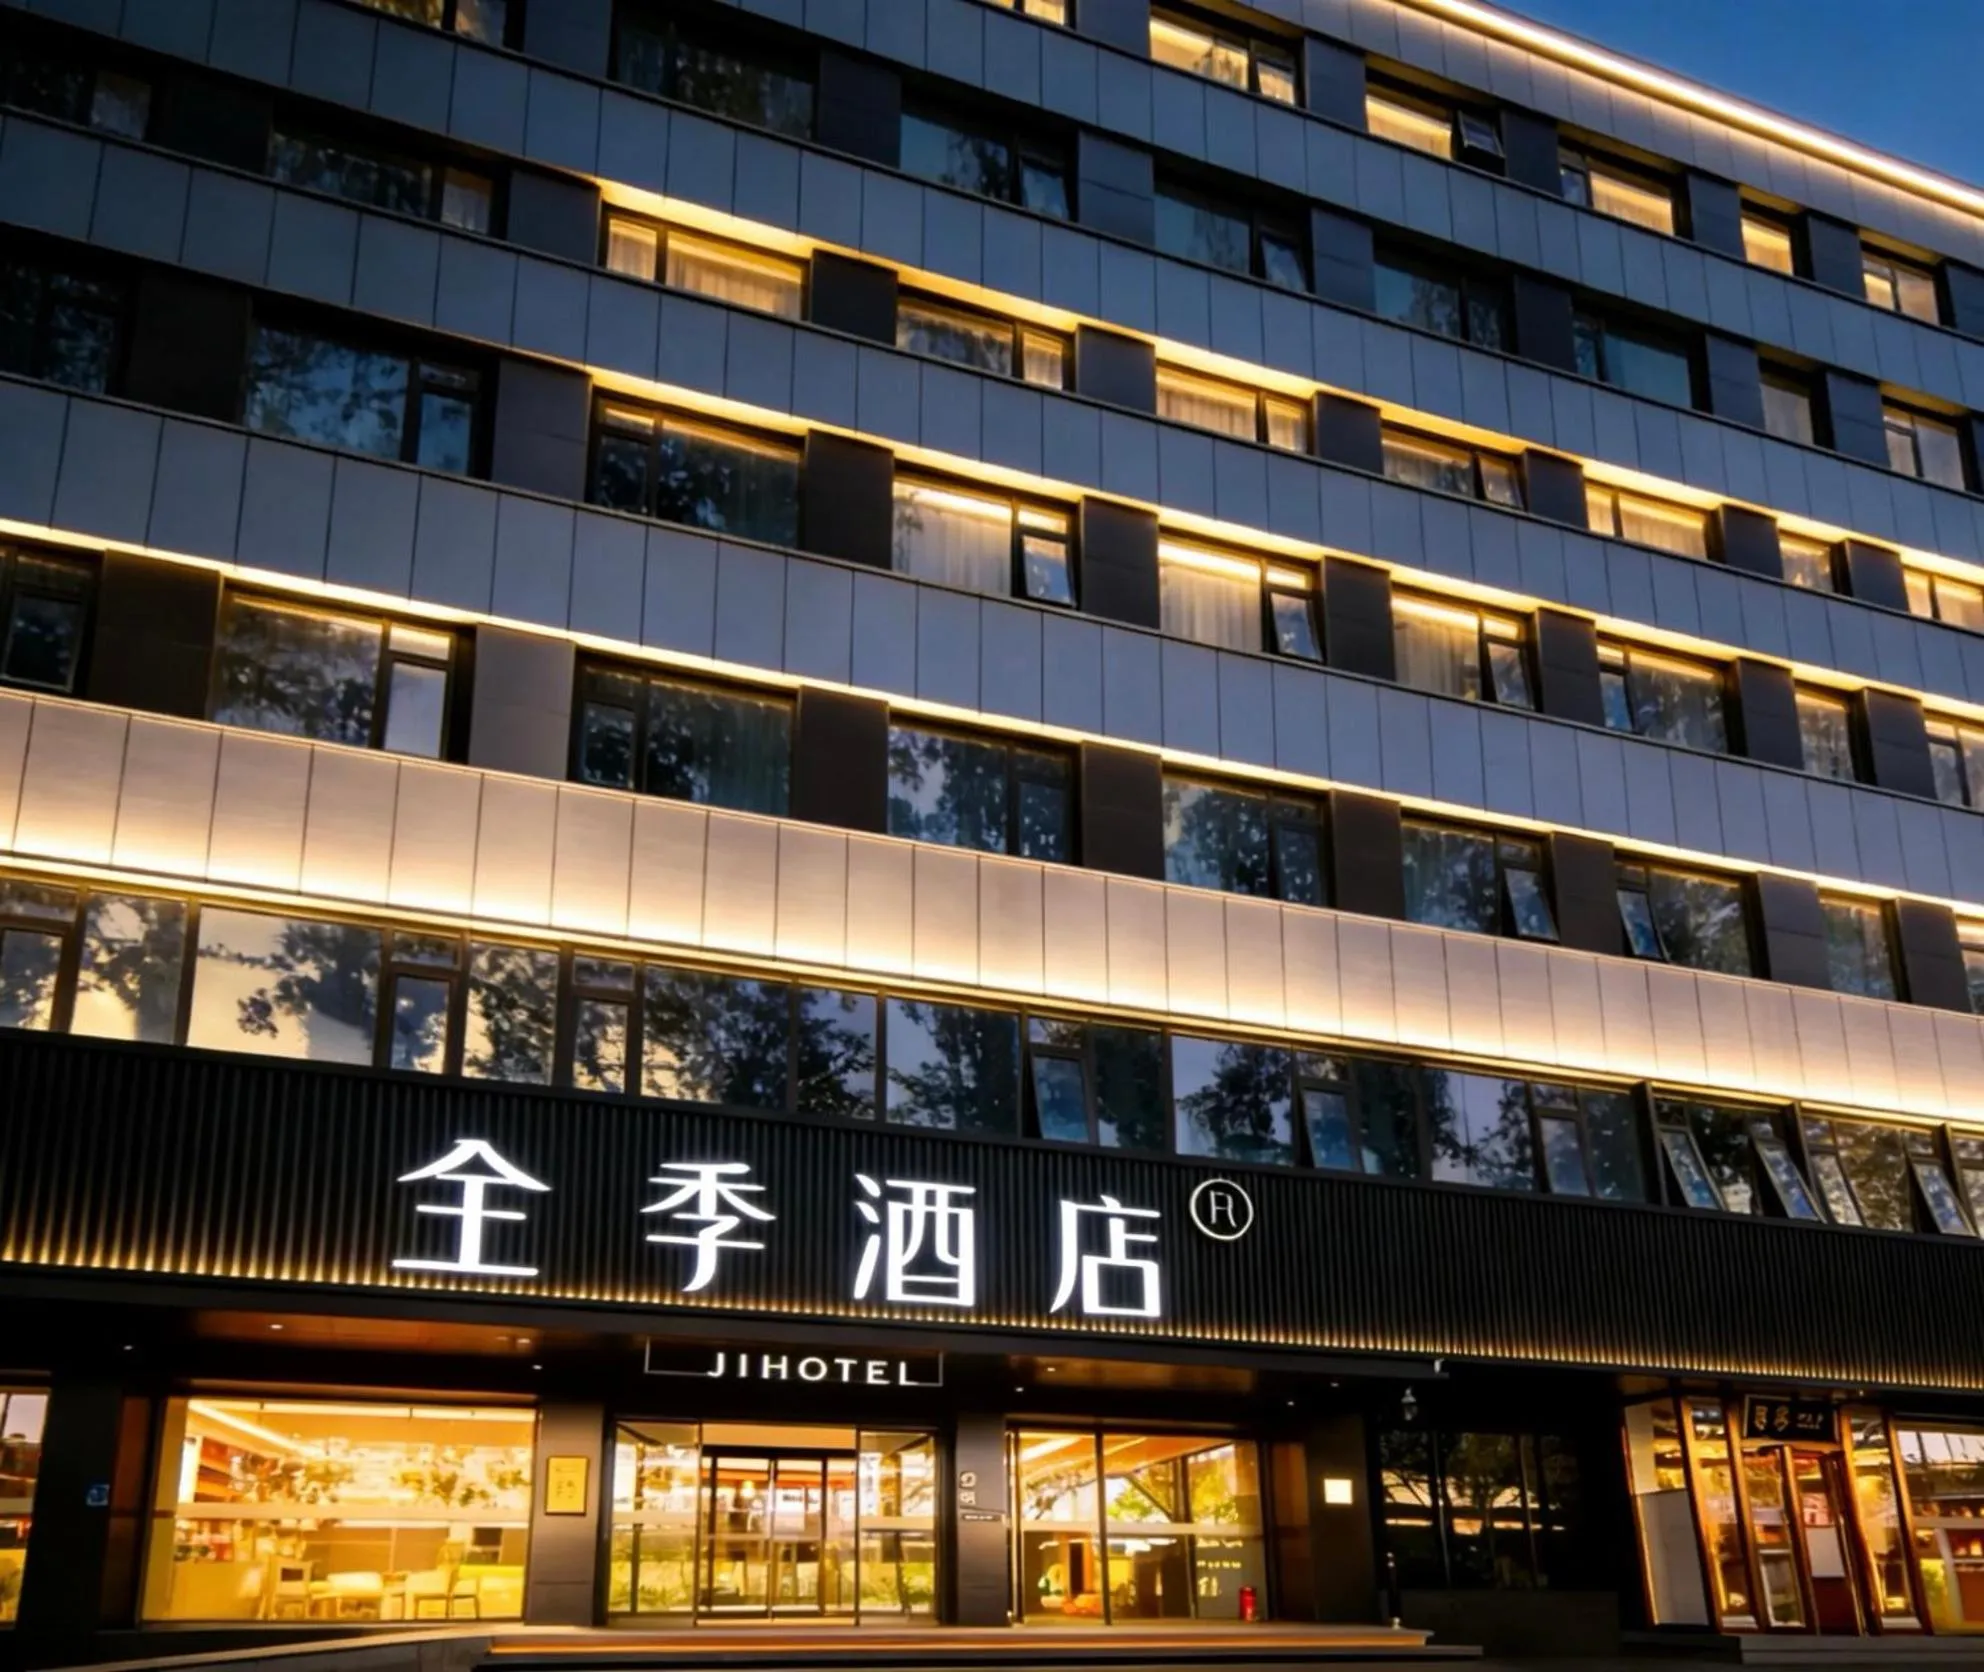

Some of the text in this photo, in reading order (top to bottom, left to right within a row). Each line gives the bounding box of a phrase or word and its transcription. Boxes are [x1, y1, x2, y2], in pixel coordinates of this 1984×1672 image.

[391, 1138, 1162, 1319] 全季酒店
[706, 1351, 919, 1387] JIHOTEL
